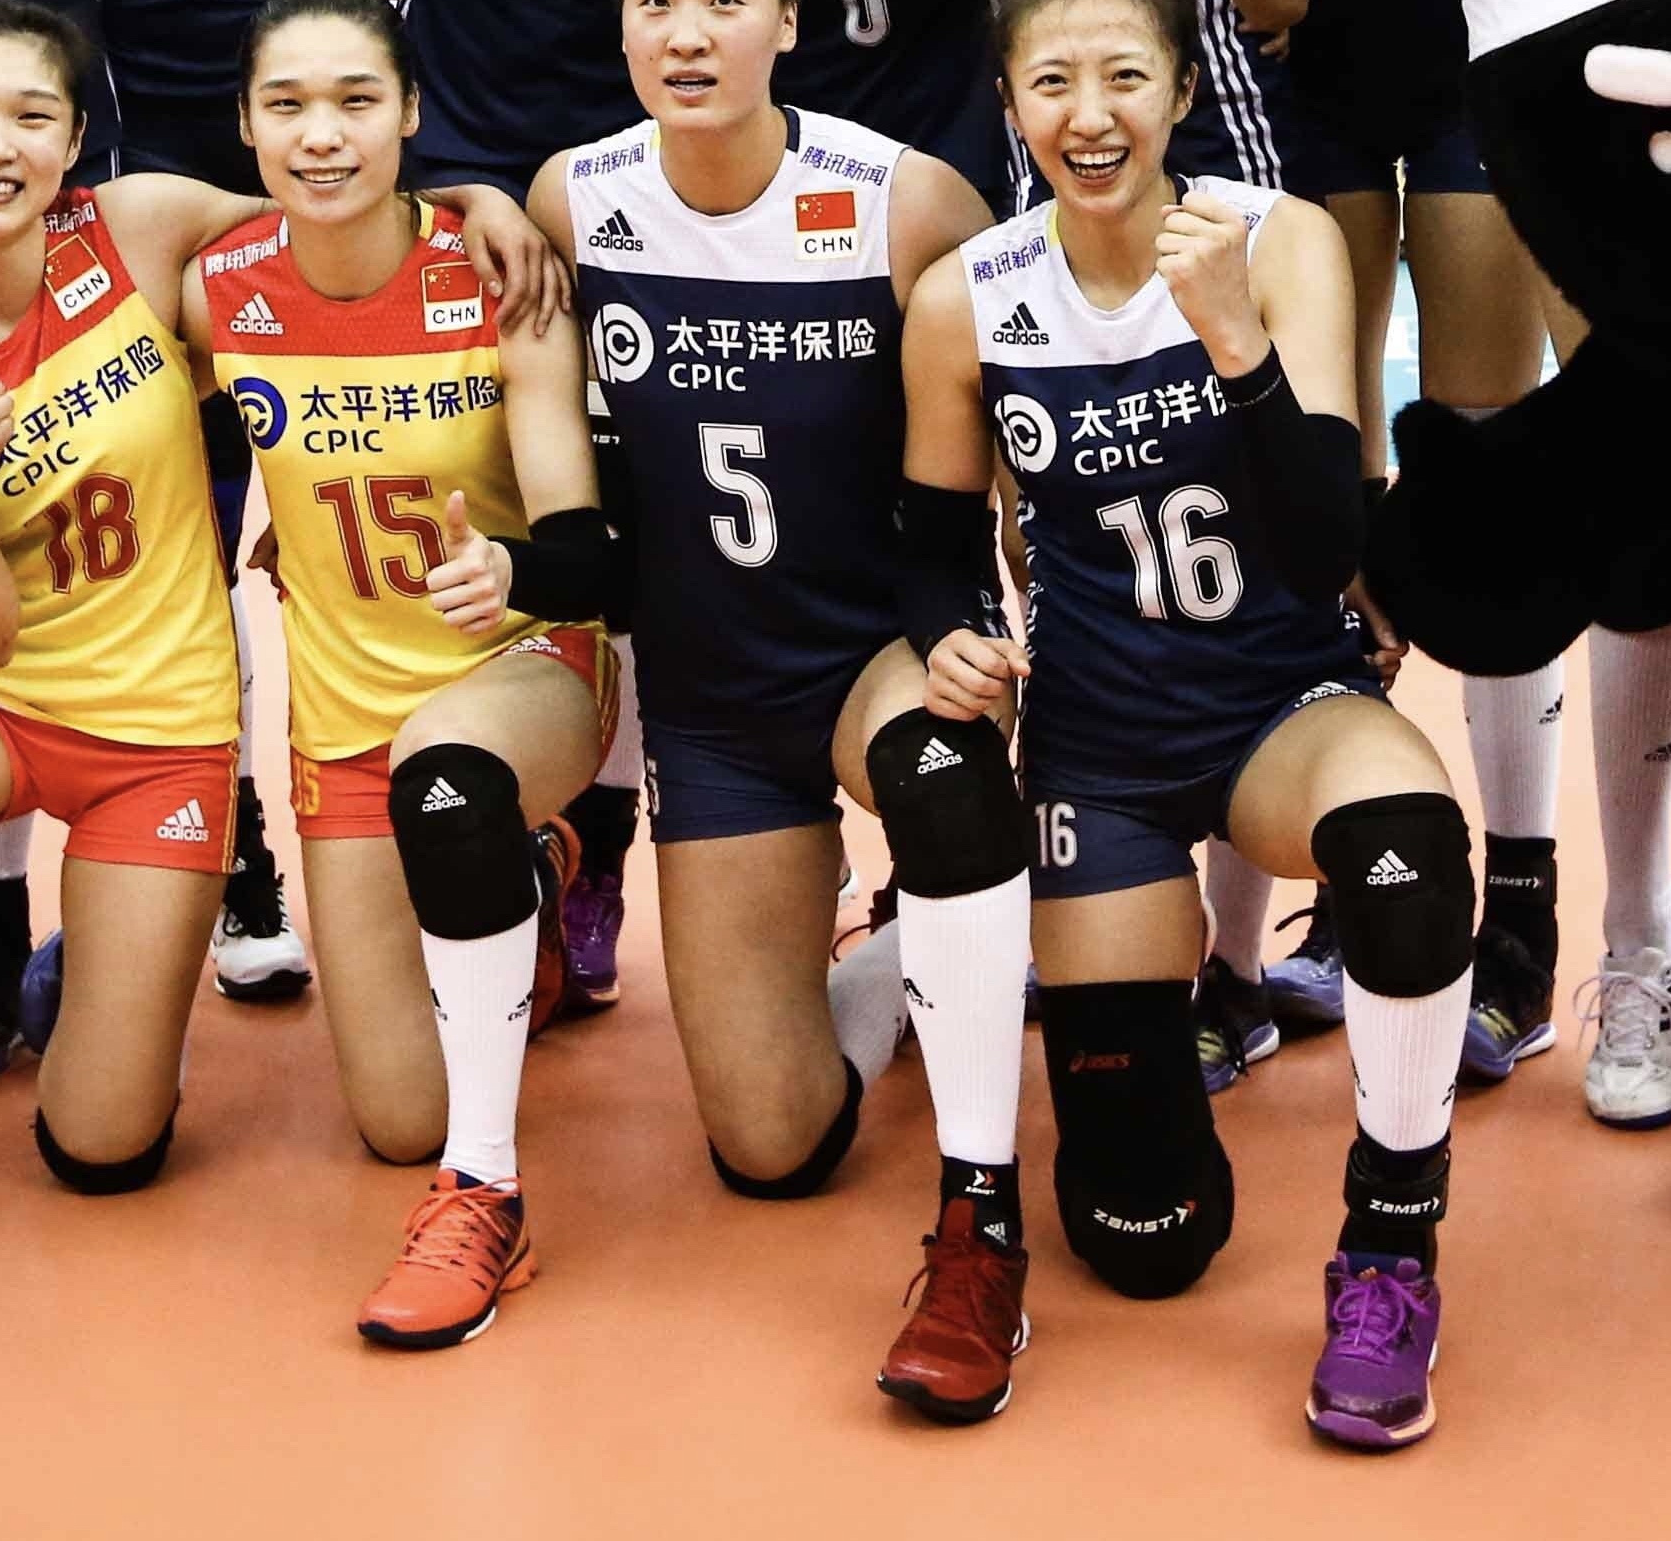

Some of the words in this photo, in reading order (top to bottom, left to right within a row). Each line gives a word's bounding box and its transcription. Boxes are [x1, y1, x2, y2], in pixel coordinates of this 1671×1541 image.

[572, 142, 645, 179] 腾讯新闻
[799, 145, 888, 187] 腾讯新闻
[205, 239, 279, 277] 腾讯新闻
[588, 233, 644, 252] adidas
[804, 235, 854, 255] CHN
[973, 235, 1048, 285] 腾讯新闻
[63, 273, 107, 310] CHN
[230, 318, 284, 336] adidas
[432, 305, 478, 326] CHN
[666, 316, 877, 362] 太平洋保险
[992, 327, 1050, 347] adidas
[668, 362, 747, 392] CPIC
[300, 376, 503, 423] 太平洋保险
[304, 428, 384, 455] CPIC
[1074, 438, 1164, 477] CPIC
[1, 441, 80, 498] CPIC
[698, 422, 778, 568] 5
[38, 473, 141, 595] 18
[314, 475, 448, 601] 15
[1096, 484, 1244, 622] 16
[917, 752, 963, 776] adidas
[421, 794, 468, 813] adidas
[156, 824, 210, 843] adidas
[1034, 802, 1077, 867] 16
[1366, 870, 1419, 887] adidas
